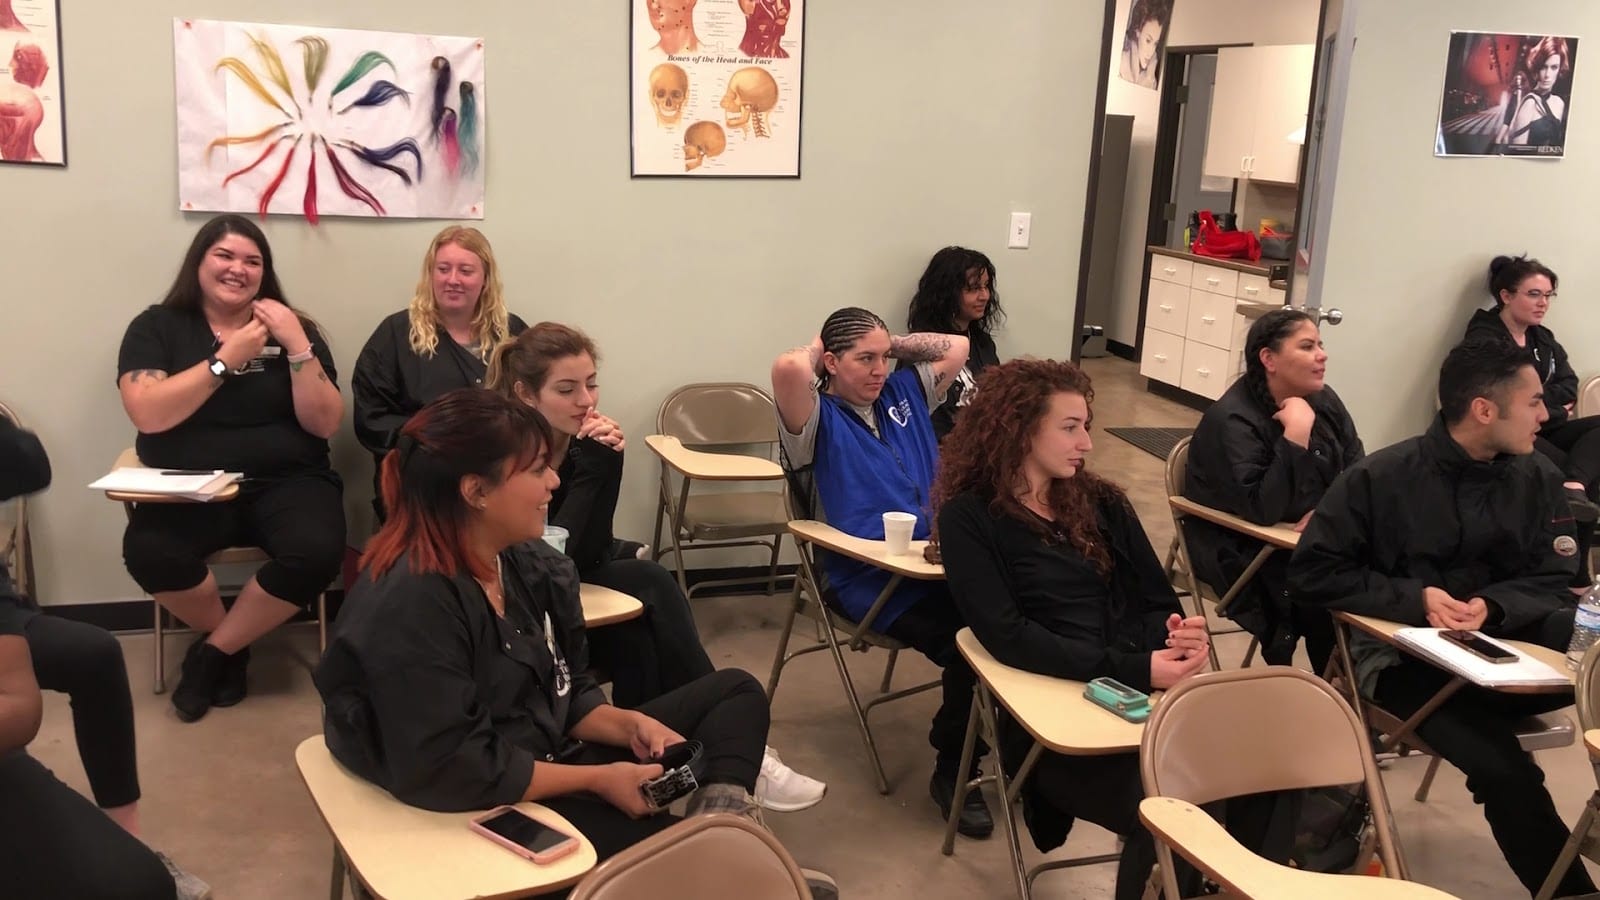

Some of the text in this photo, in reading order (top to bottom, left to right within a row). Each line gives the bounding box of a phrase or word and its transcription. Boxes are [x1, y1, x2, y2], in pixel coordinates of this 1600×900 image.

[692, 55, 701, 64] of
[716, 56, 736, 64] Head
[1537, 145, 1563, 153] REDKEN
